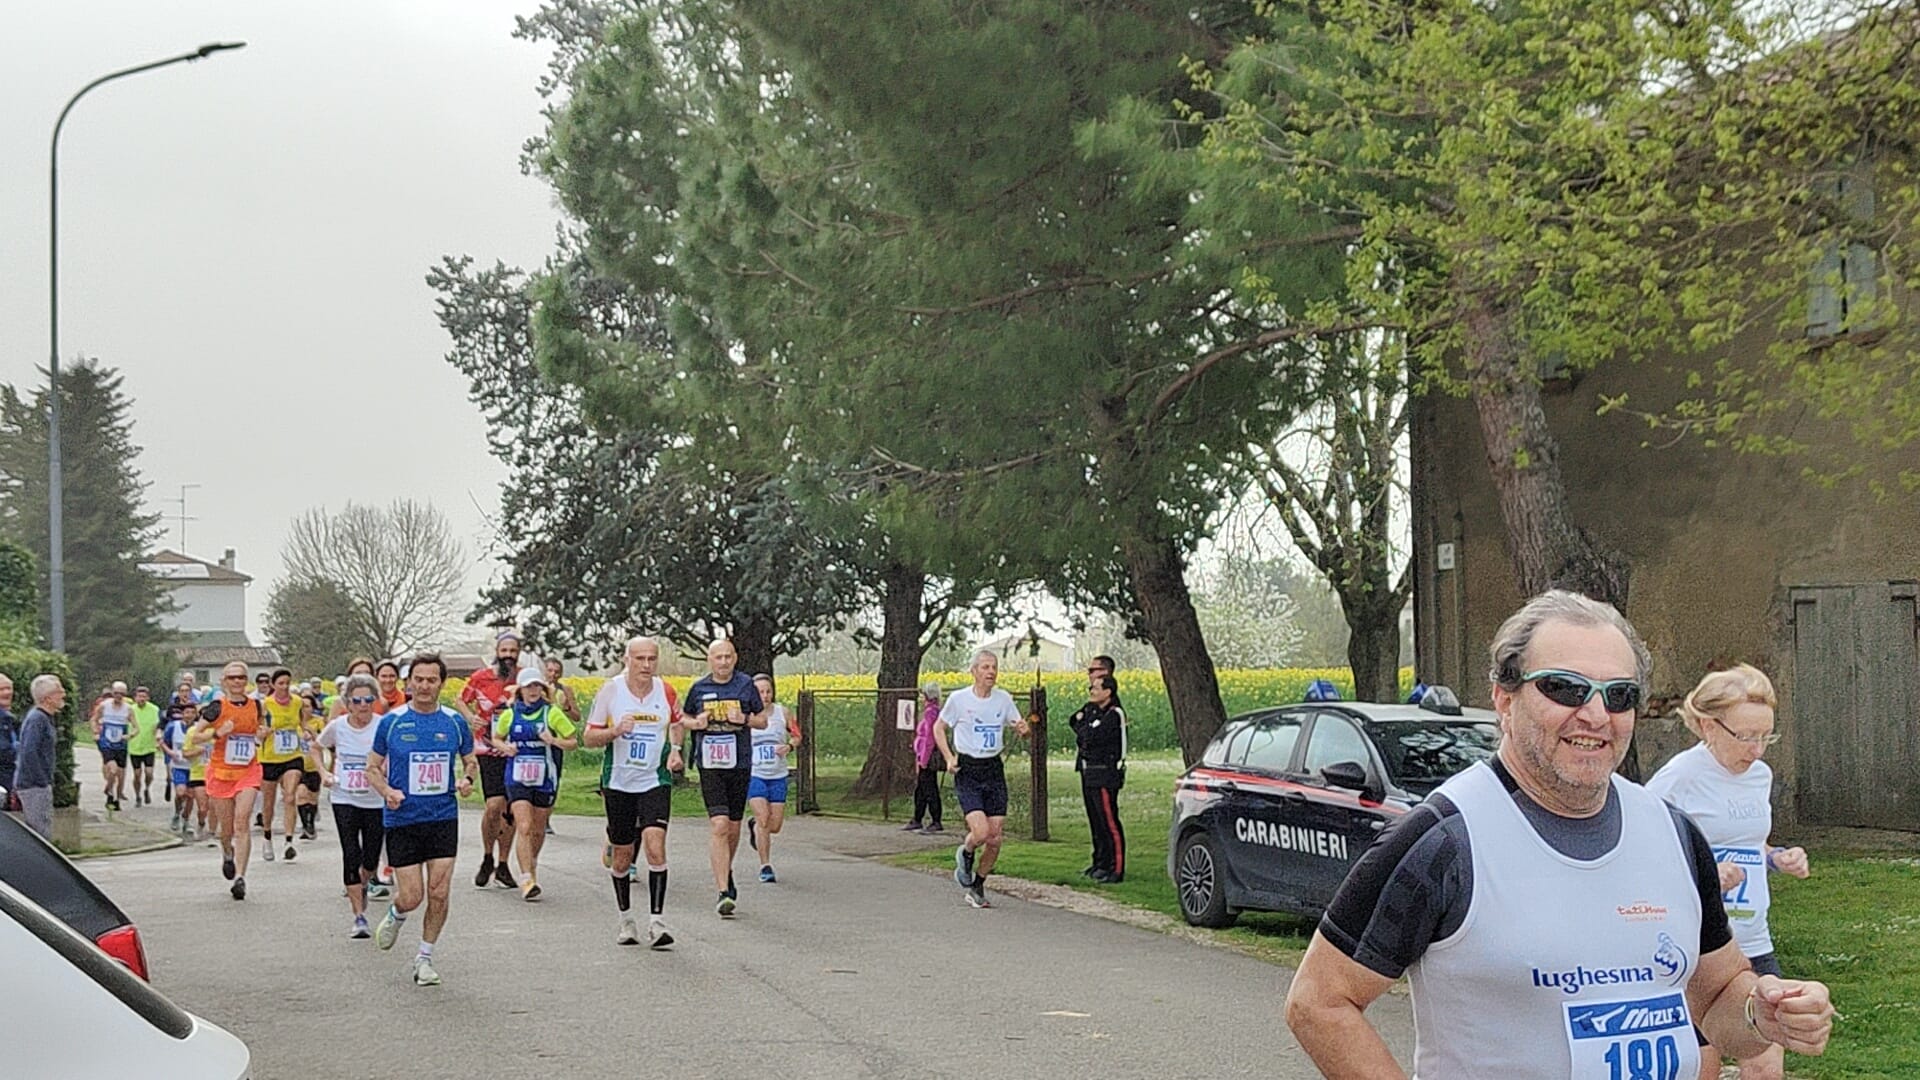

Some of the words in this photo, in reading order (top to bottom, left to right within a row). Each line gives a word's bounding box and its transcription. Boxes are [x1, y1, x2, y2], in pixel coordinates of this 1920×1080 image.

[235, 741, 250, 757] 112
[983, 732, 995, 748] 20
[630, 741, 646, 760] 80
[417, 763, 443, 784] 240
[1236, 817, 1348, 860] CARABINIERI
[1532, 966, 1654, 994] lughesina
